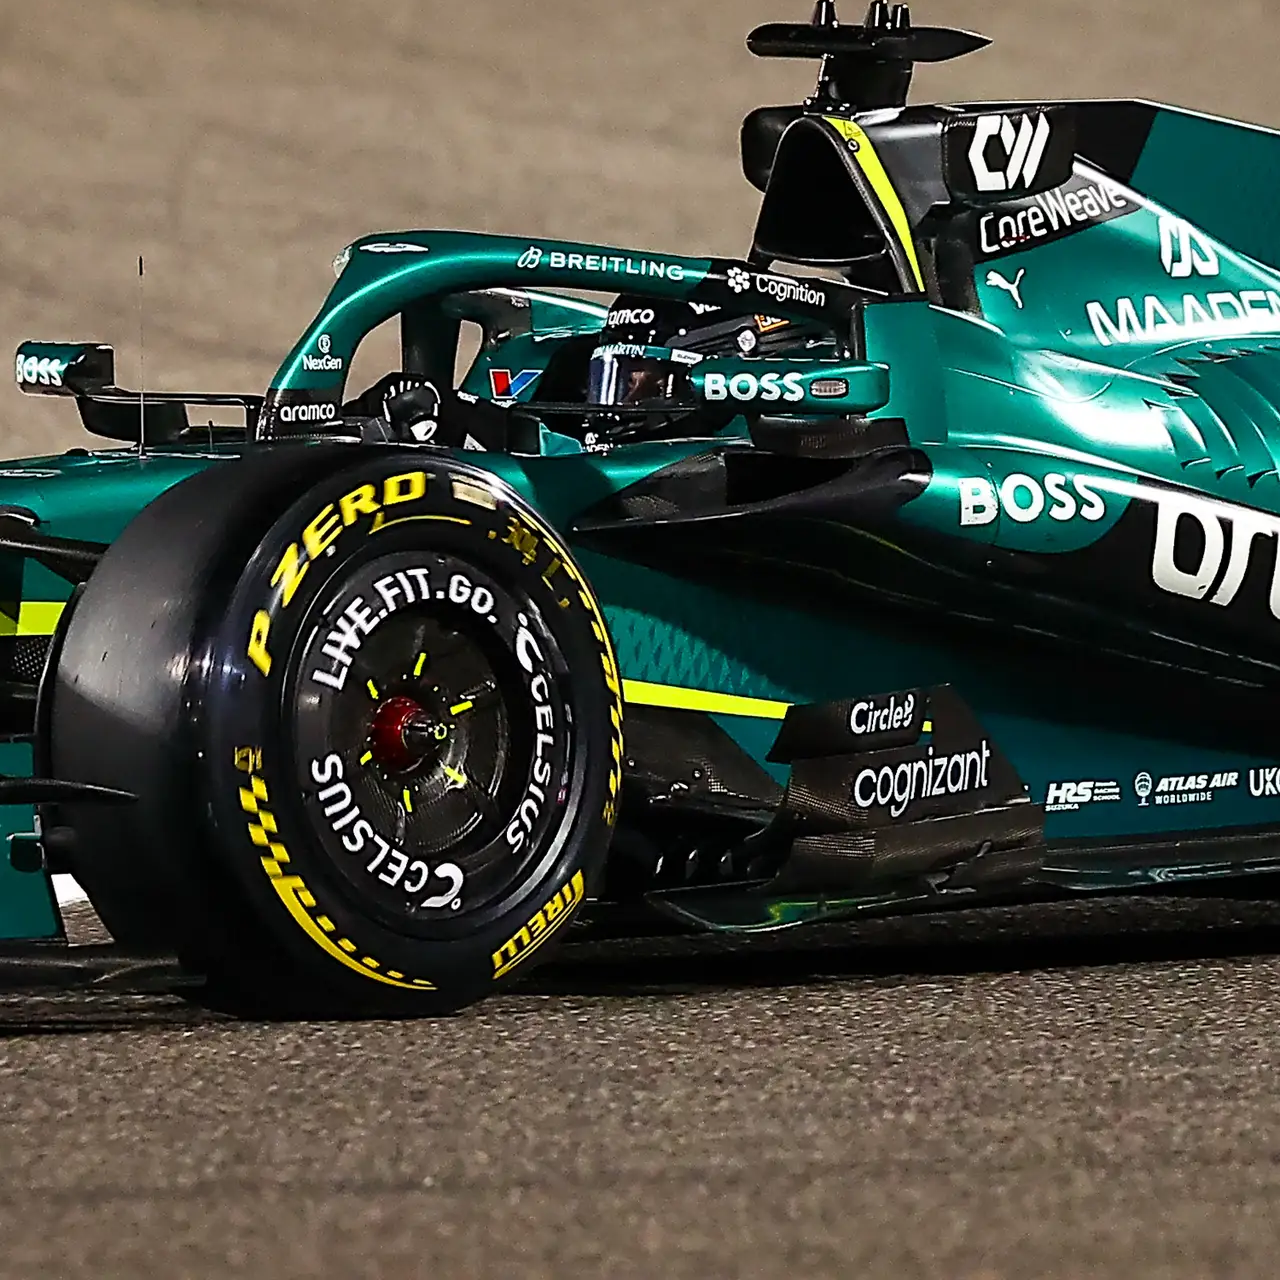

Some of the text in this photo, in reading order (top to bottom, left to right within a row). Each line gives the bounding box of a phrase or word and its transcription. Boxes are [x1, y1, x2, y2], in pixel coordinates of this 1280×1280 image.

[979, 180, 1127, 254] CoreWeave
[549, 253, 686, 281] BREITLING
[756, 277, 826, 308] Cognition
[16, 353, 65, 387] BOSS
[303, 354, 342, 371] NexGen
[705, 372, 805, 402] BOSS
[280, 402, 336, 422] aramco
[959, 472, 1106, 526] BOSS
[247, 470, 427, 678] P ZERO
[507, 672, 554, 856] CELSIUS
[854, 739, 991, 818] cognizant
[1046, 781, 1094, 805] HRS
[1155, 771, 1239, 792] ATLAS AIR
[1045, 803, 1079, 812] SUZUKA
[1155, 791, 1213, 805] WORLDWIDE
[312, 752, 429, 894] CELSIUS
[491, 869, 586, 980] PIRELLI
